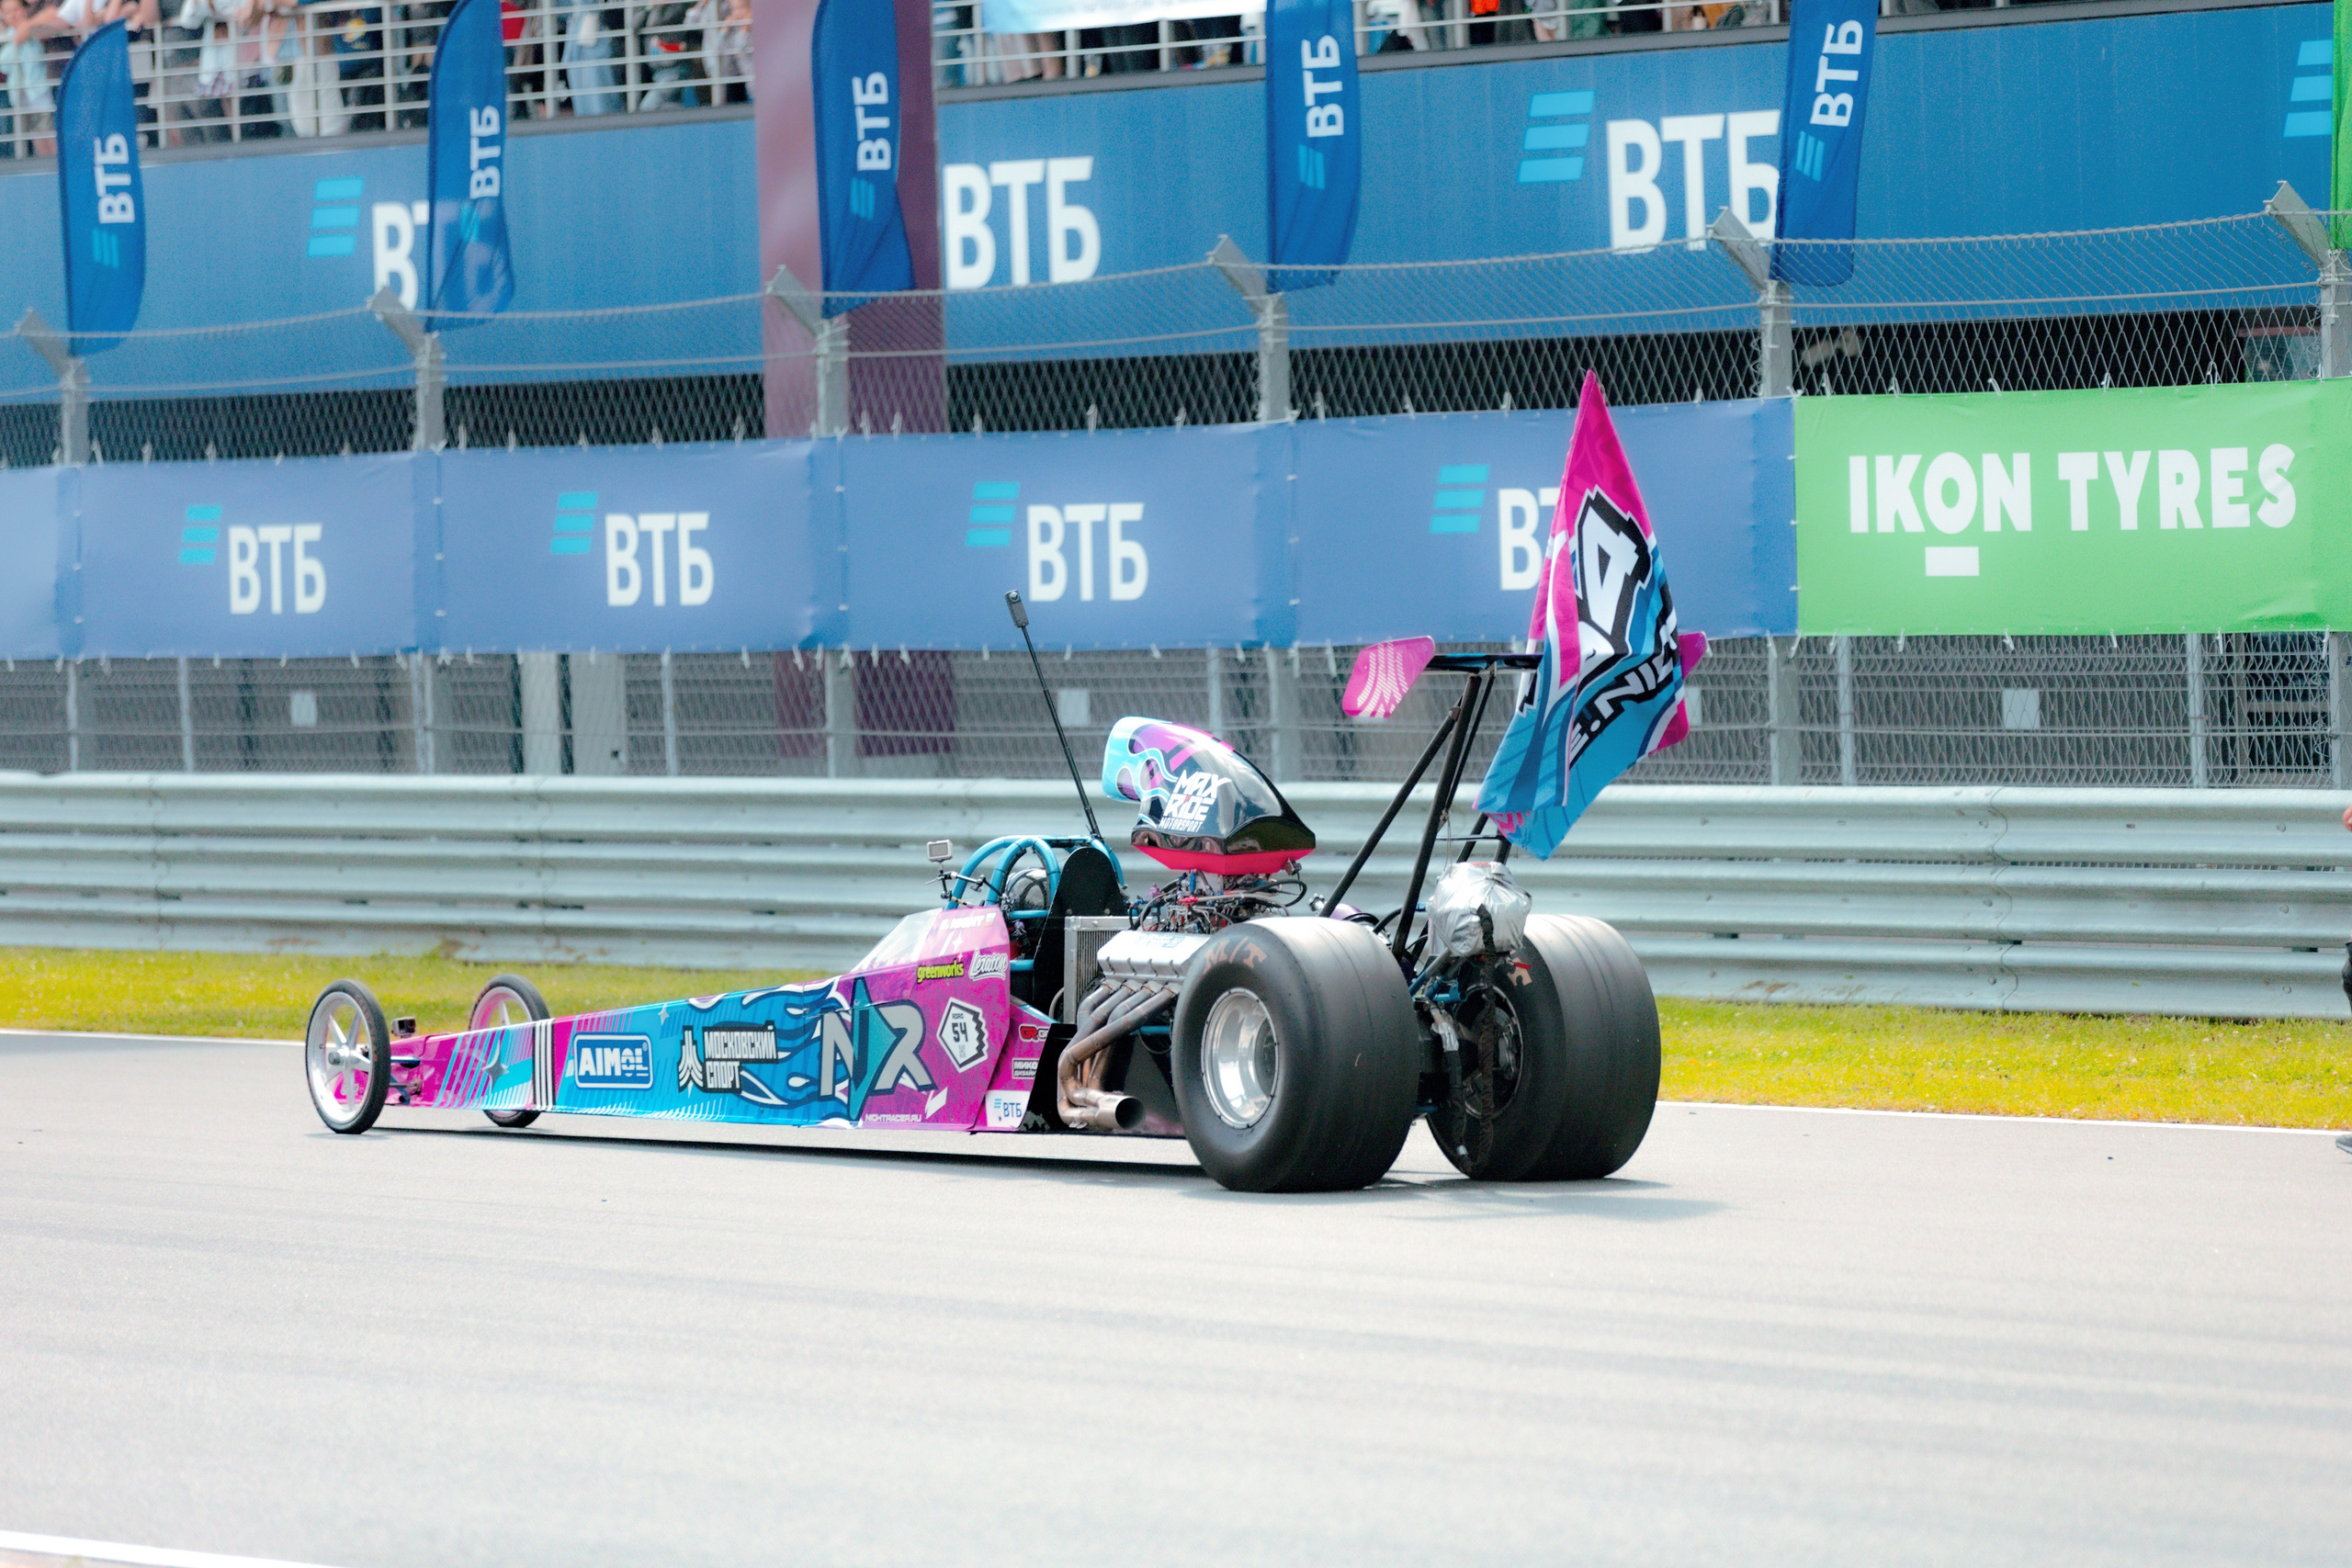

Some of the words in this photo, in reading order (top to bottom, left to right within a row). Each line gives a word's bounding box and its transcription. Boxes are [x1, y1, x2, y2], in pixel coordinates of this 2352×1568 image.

[1301, 34, 1345, 138] ВТБ
[1810, 19, 1863, 128] ВТБ
[469, 104, 502, 199] ВТБ
[852, 71, 892, 172] ВТБ
[93, 132, 135, 224] ВТБ
[943, 155, 1102, 290] ВТБ
[1606, 108, 1781, 254] ВТБ
[1849, 451, 2033, 535] IKON
[2057, 443, 2297, 532] TYRES
[228, 523, 327, 615] ВТБ
[605, 511, 716, 607] ВТБ
[1026, 502, 1149, 603] ВТБ
[1159, 817, 1204, 832] MOTORSPORT
[1173, 769, 1232, 799] MAX
[917, 960, 965, 983] greenworks
[1204, 937, 1268, 975] M/T
[704, 1025, 777, 1059] МОСКОВСКИЙ
[707, 1061, 741, 1089] СПОРТ
[951, 1021, 968, 1043] 54
[1003, 1102, 1022, 1118] ВТБ
